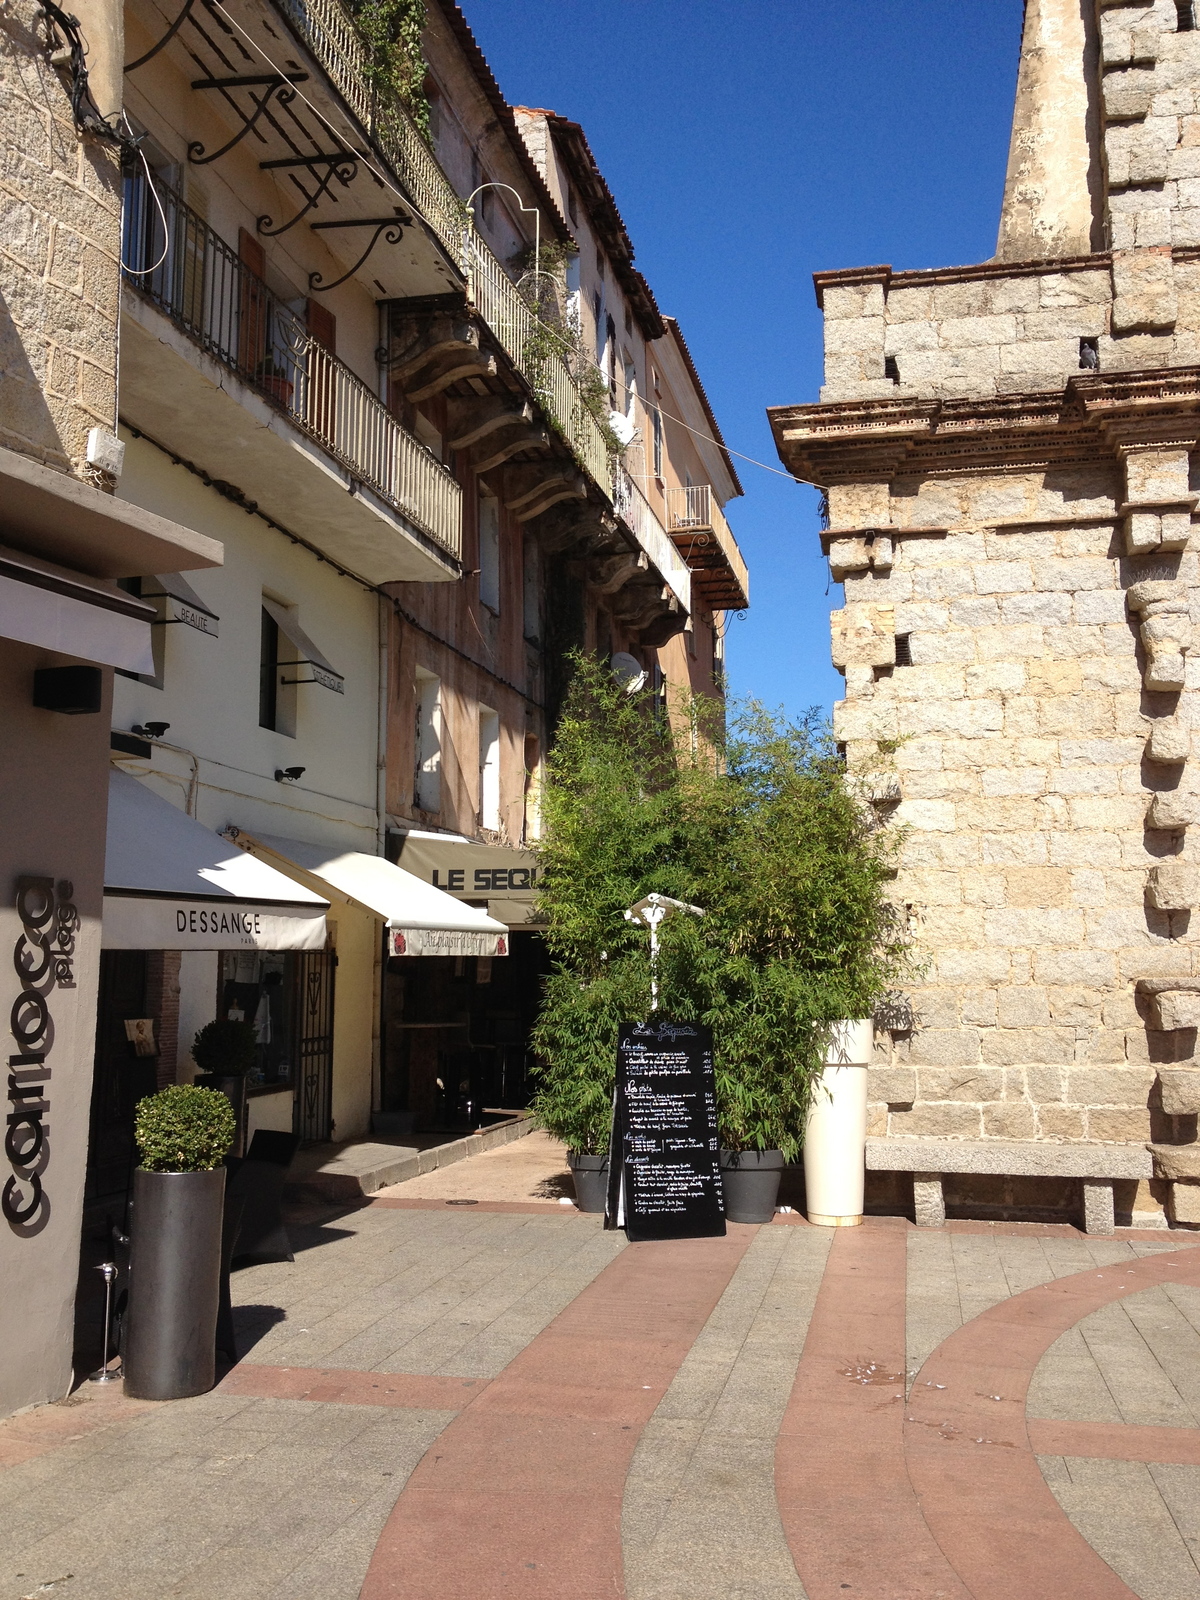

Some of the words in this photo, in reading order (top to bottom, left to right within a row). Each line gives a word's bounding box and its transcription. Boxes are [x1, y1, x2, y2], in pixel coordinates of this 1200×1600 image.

[432, 869, 465, 890] LE
[176, 909, 261, 934] DESSANGE
[624, 1079, 638, 1094] Nos
